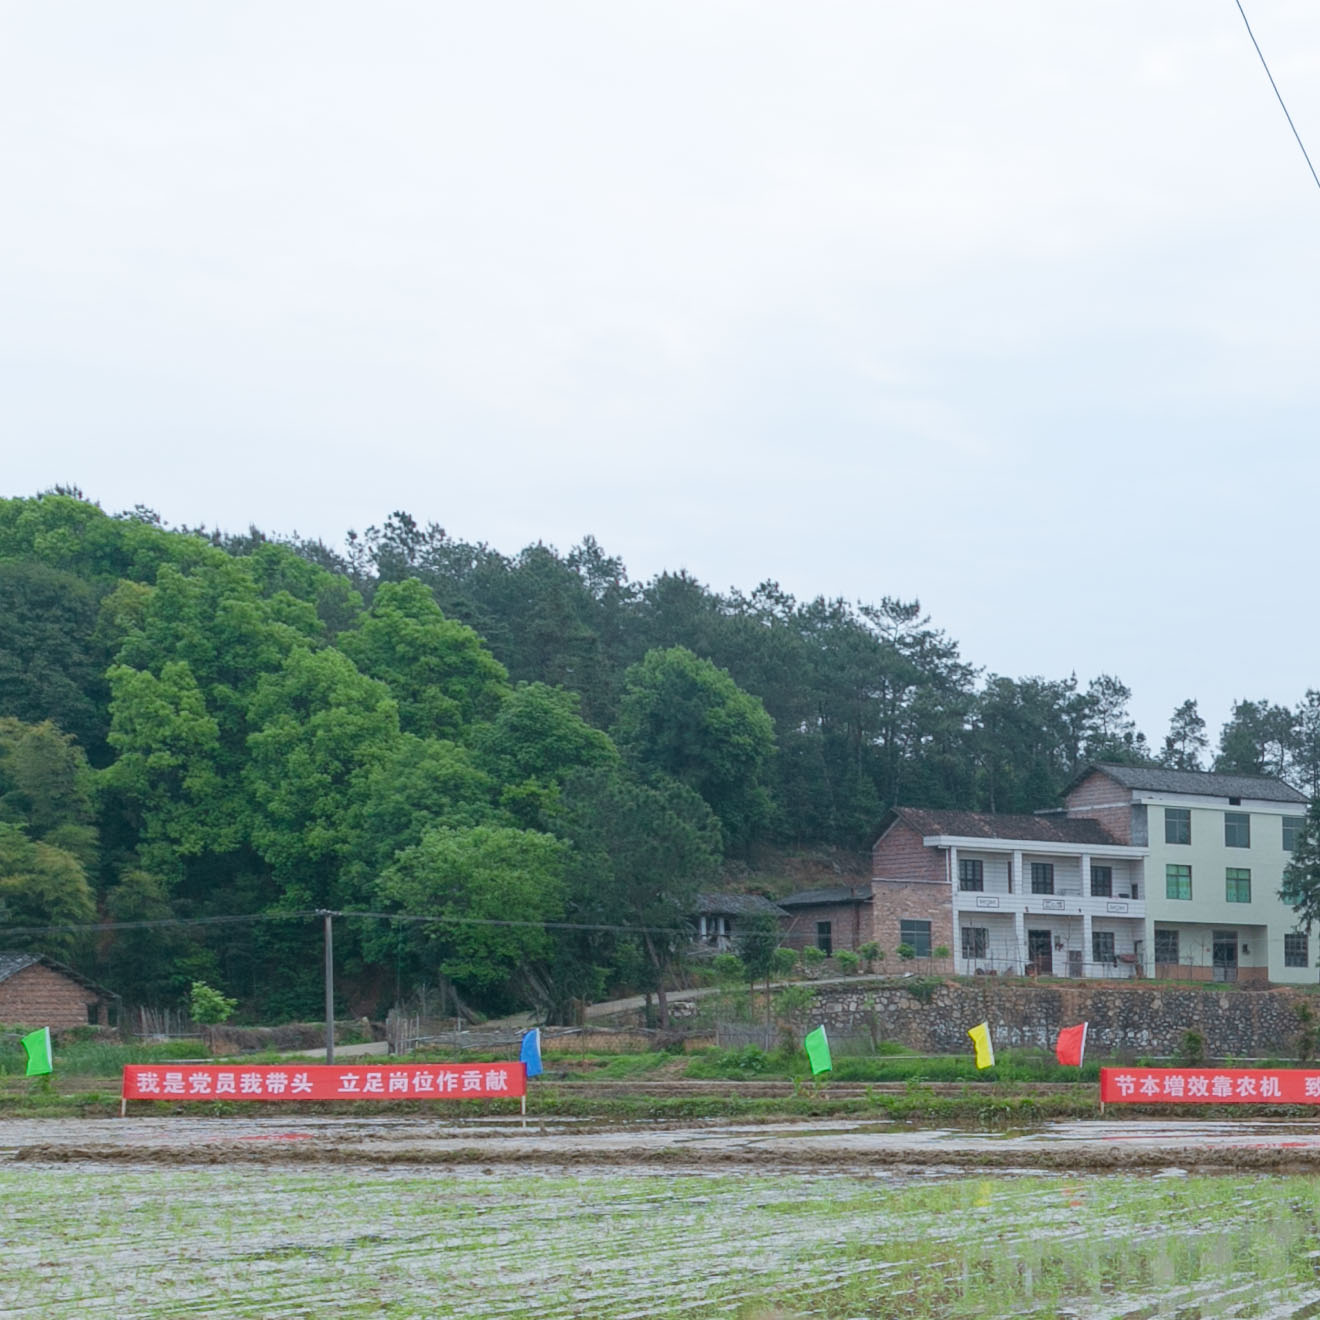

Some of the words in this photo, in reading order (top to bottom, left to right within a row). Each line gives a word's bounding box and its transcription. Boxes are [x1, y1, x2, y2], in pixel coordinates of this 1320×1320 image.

[137, 1071, 313, 1094] 我是党员我带头
[338, 1070, 507, 1093] 立足岗位作贡献
[1114, 1074, 1281, 1097] 节本增效靠农机
